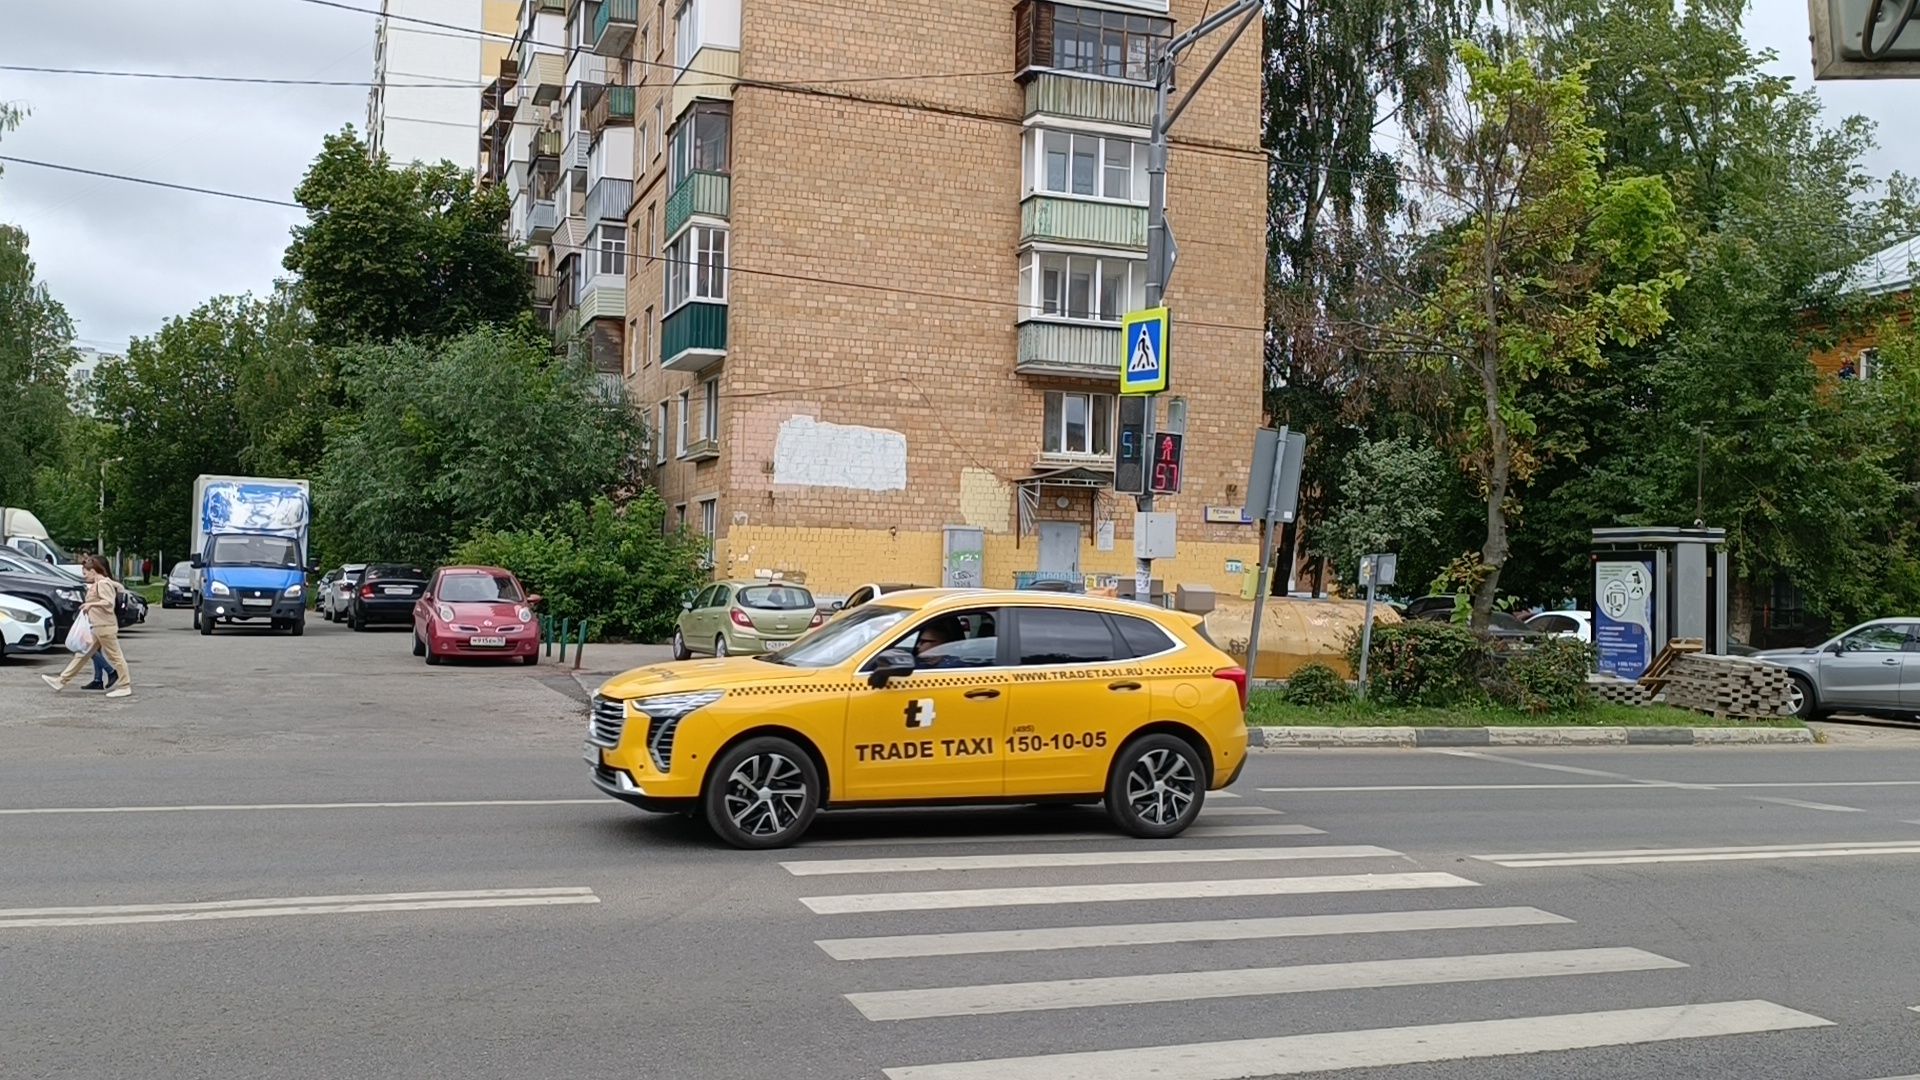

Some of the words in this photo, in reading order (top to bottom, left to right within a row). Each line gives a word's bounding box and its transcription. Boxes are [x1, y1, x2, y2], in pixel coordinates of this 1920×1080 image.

[1155, 463, 1178, 489] 57
[1012, 667, 1144, 681] WWW.TRADETAXI.RU
[855, 741, 934, 761] TRADE
[941, 737, 993, 756] TAXI
[1005, 731, 1107, 753] 150-10-05
